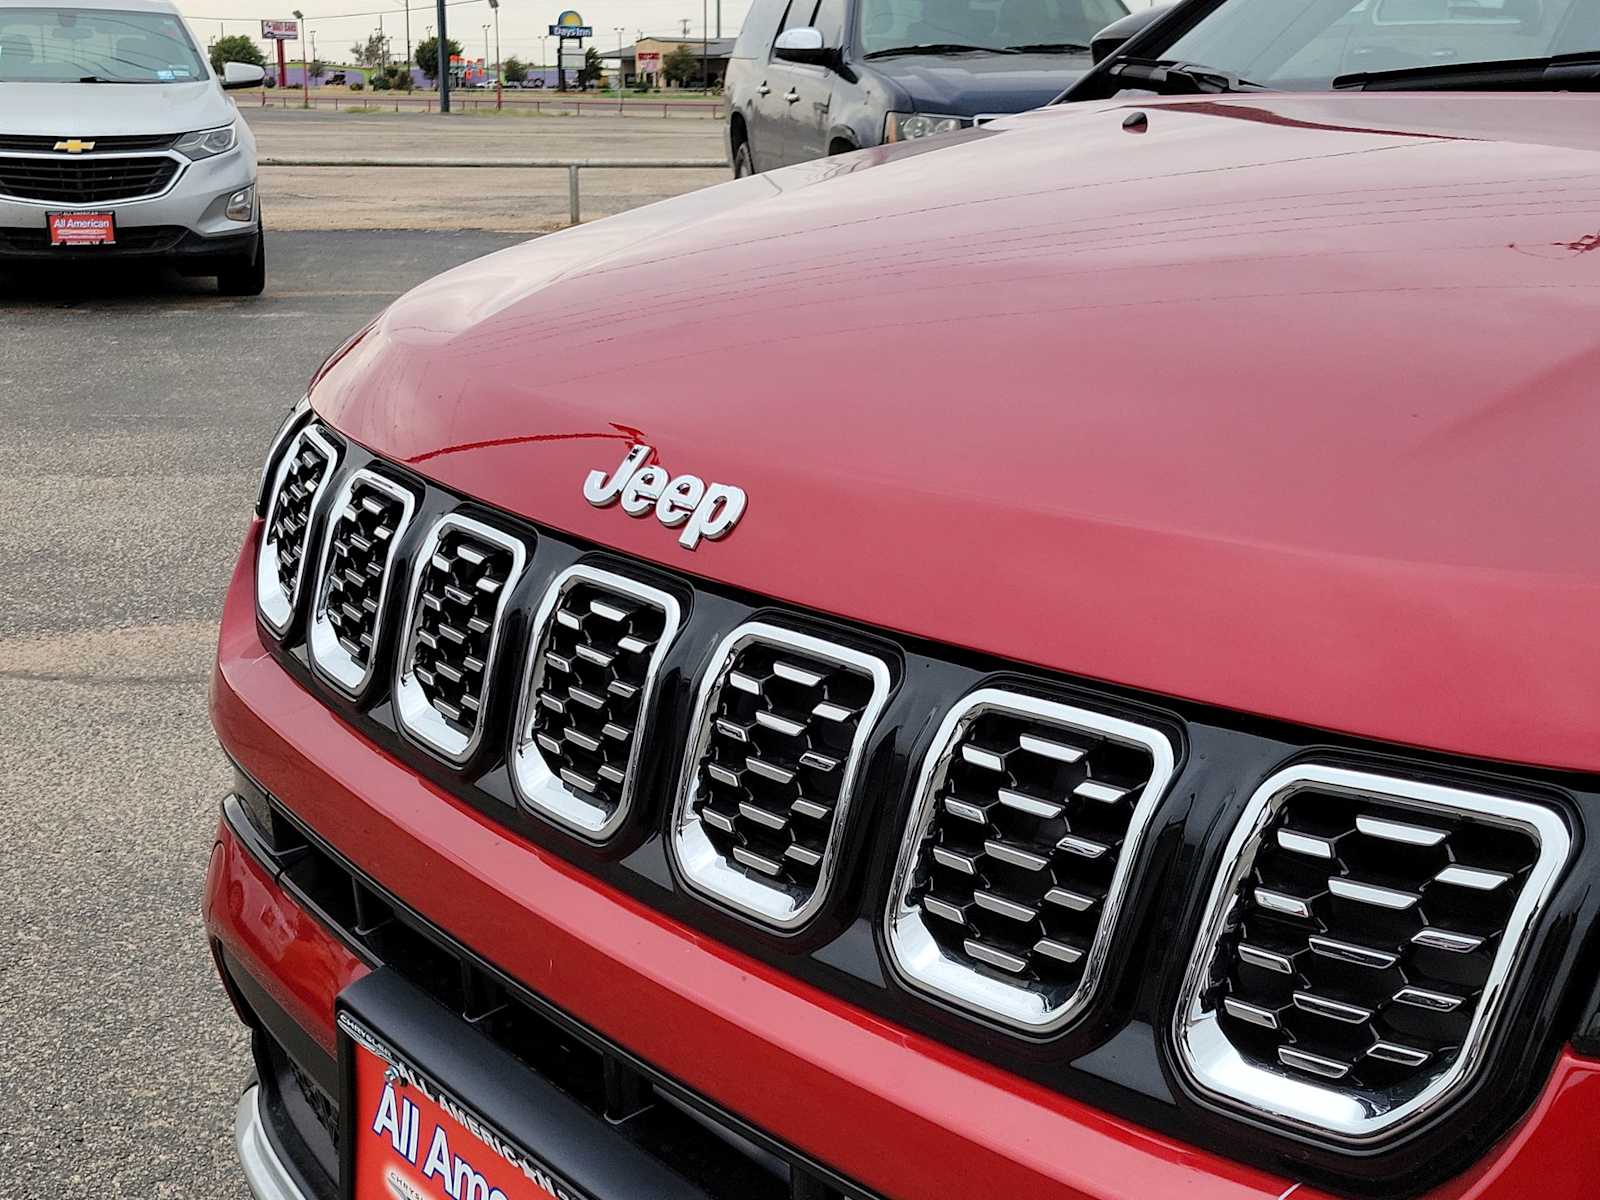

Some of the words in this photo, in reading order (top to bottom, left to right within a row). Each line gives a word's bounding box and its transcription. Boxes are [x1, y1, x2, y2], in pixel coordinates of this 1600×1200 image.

[54, 219, 66, 228] All
[67, 218, 109, 228] American
[583, 444, 749, 551] Jeep
[372, 1082, 420, 1166] All
